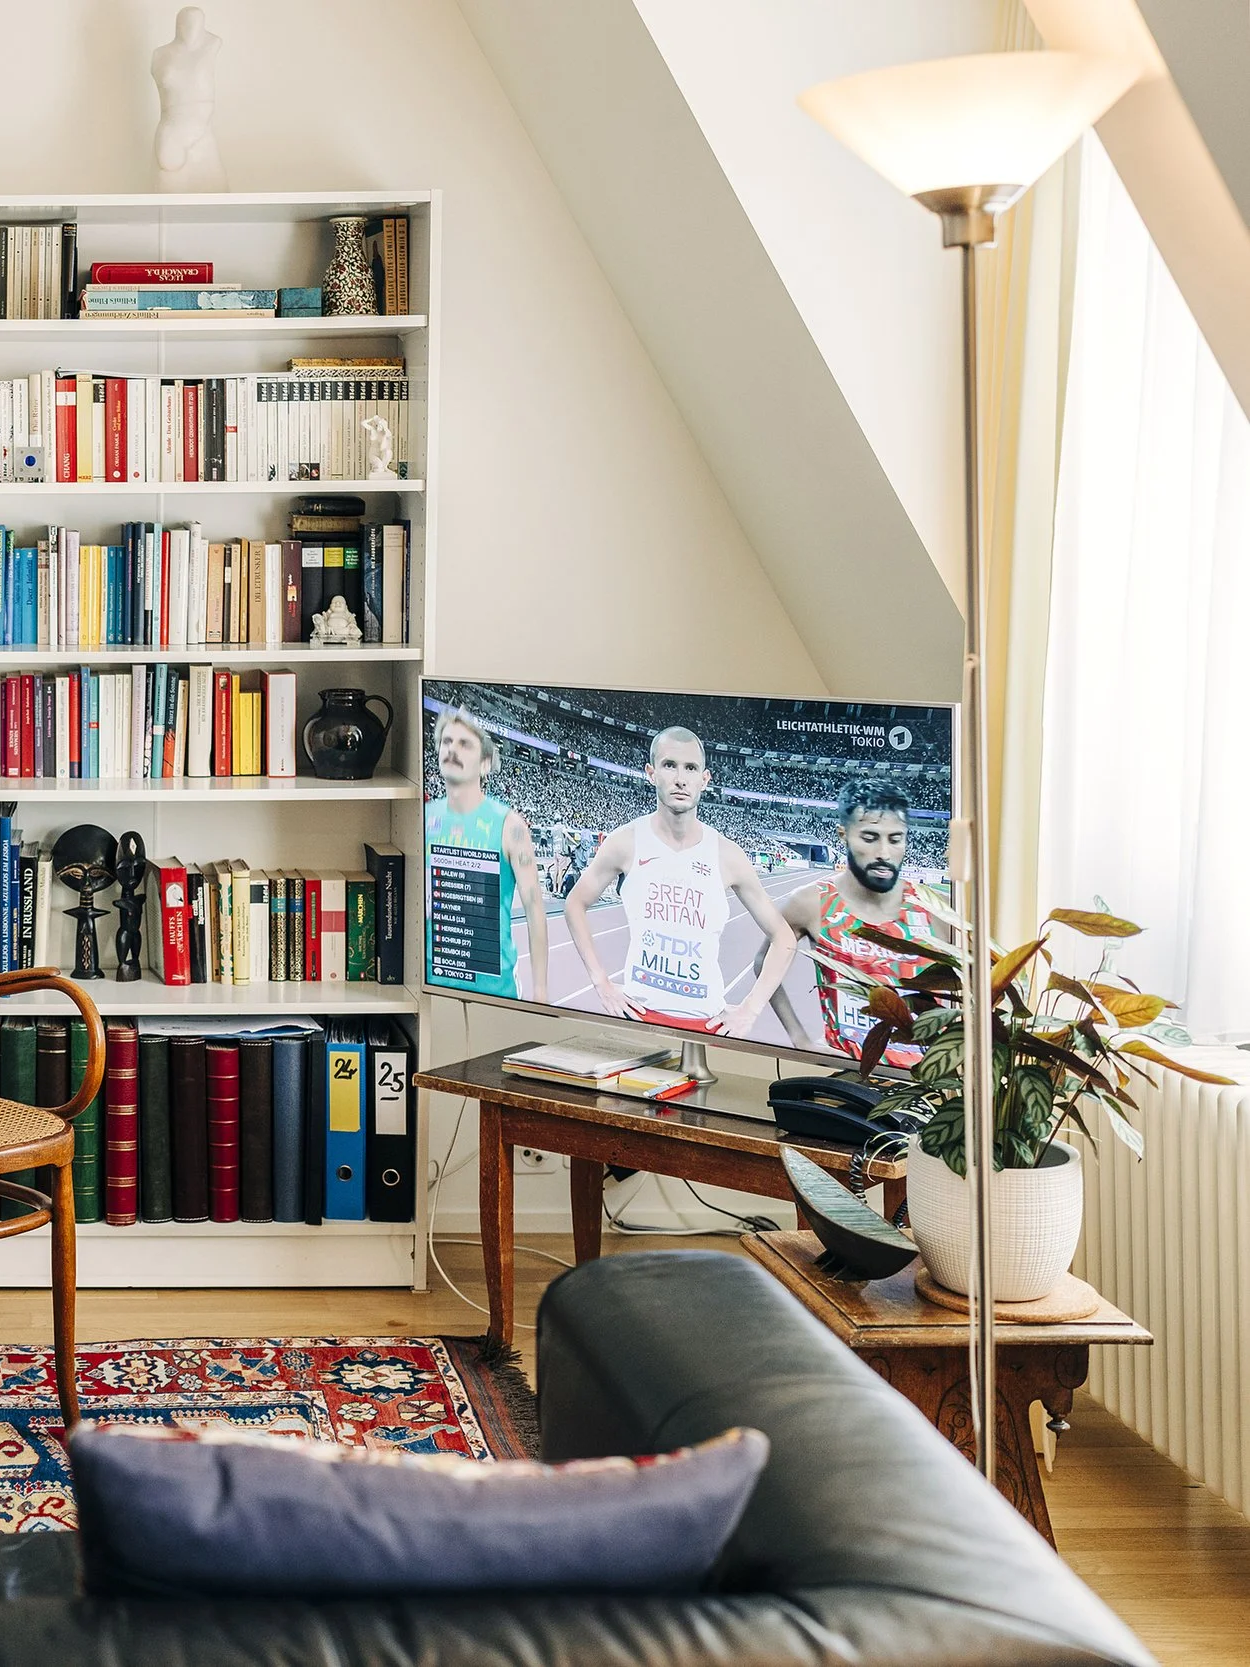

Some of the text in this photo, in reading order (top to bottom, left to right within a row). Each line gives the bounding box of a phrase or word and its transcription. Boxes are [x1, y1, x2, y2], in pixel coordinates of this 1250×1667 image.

[161, 268, 198, 277] CRANACH
[85, 311, 159, 319] Fellini's Zeichnungen
[776, 720, 885, 736] LEICHTATHLETIK-WM
[850, 736, 885, 748] TOKIO
[433, 847, 498, 861] STARTLIST WORLD RANK
[434, 857, 452, 865] 5000m
[2, 863, 9, 872] EM
[440, 870, 458, 878] BALEW
[464, 883, 472, 891] (7)
[649, 882, 704, 909] GREAT
[23, 868, 33, 939] IN RUSSLAND
[441, 902, 461, 911] RAYNER
[441, 913, 456, 922] MILLS
[441, 924, 464, 934] HERRERA
[441, 936, 461, 944] SCHRUB
[655, 933, 702, 959] TDK
[441, 947, 461, 956] KEMBOI
[641, 950, 700, 981] MILLS
[444, 968, 473, 980] TOKYO 25
[334, 1058, 358, 1080] 24
[378, 1061, 405, 1093] 25
